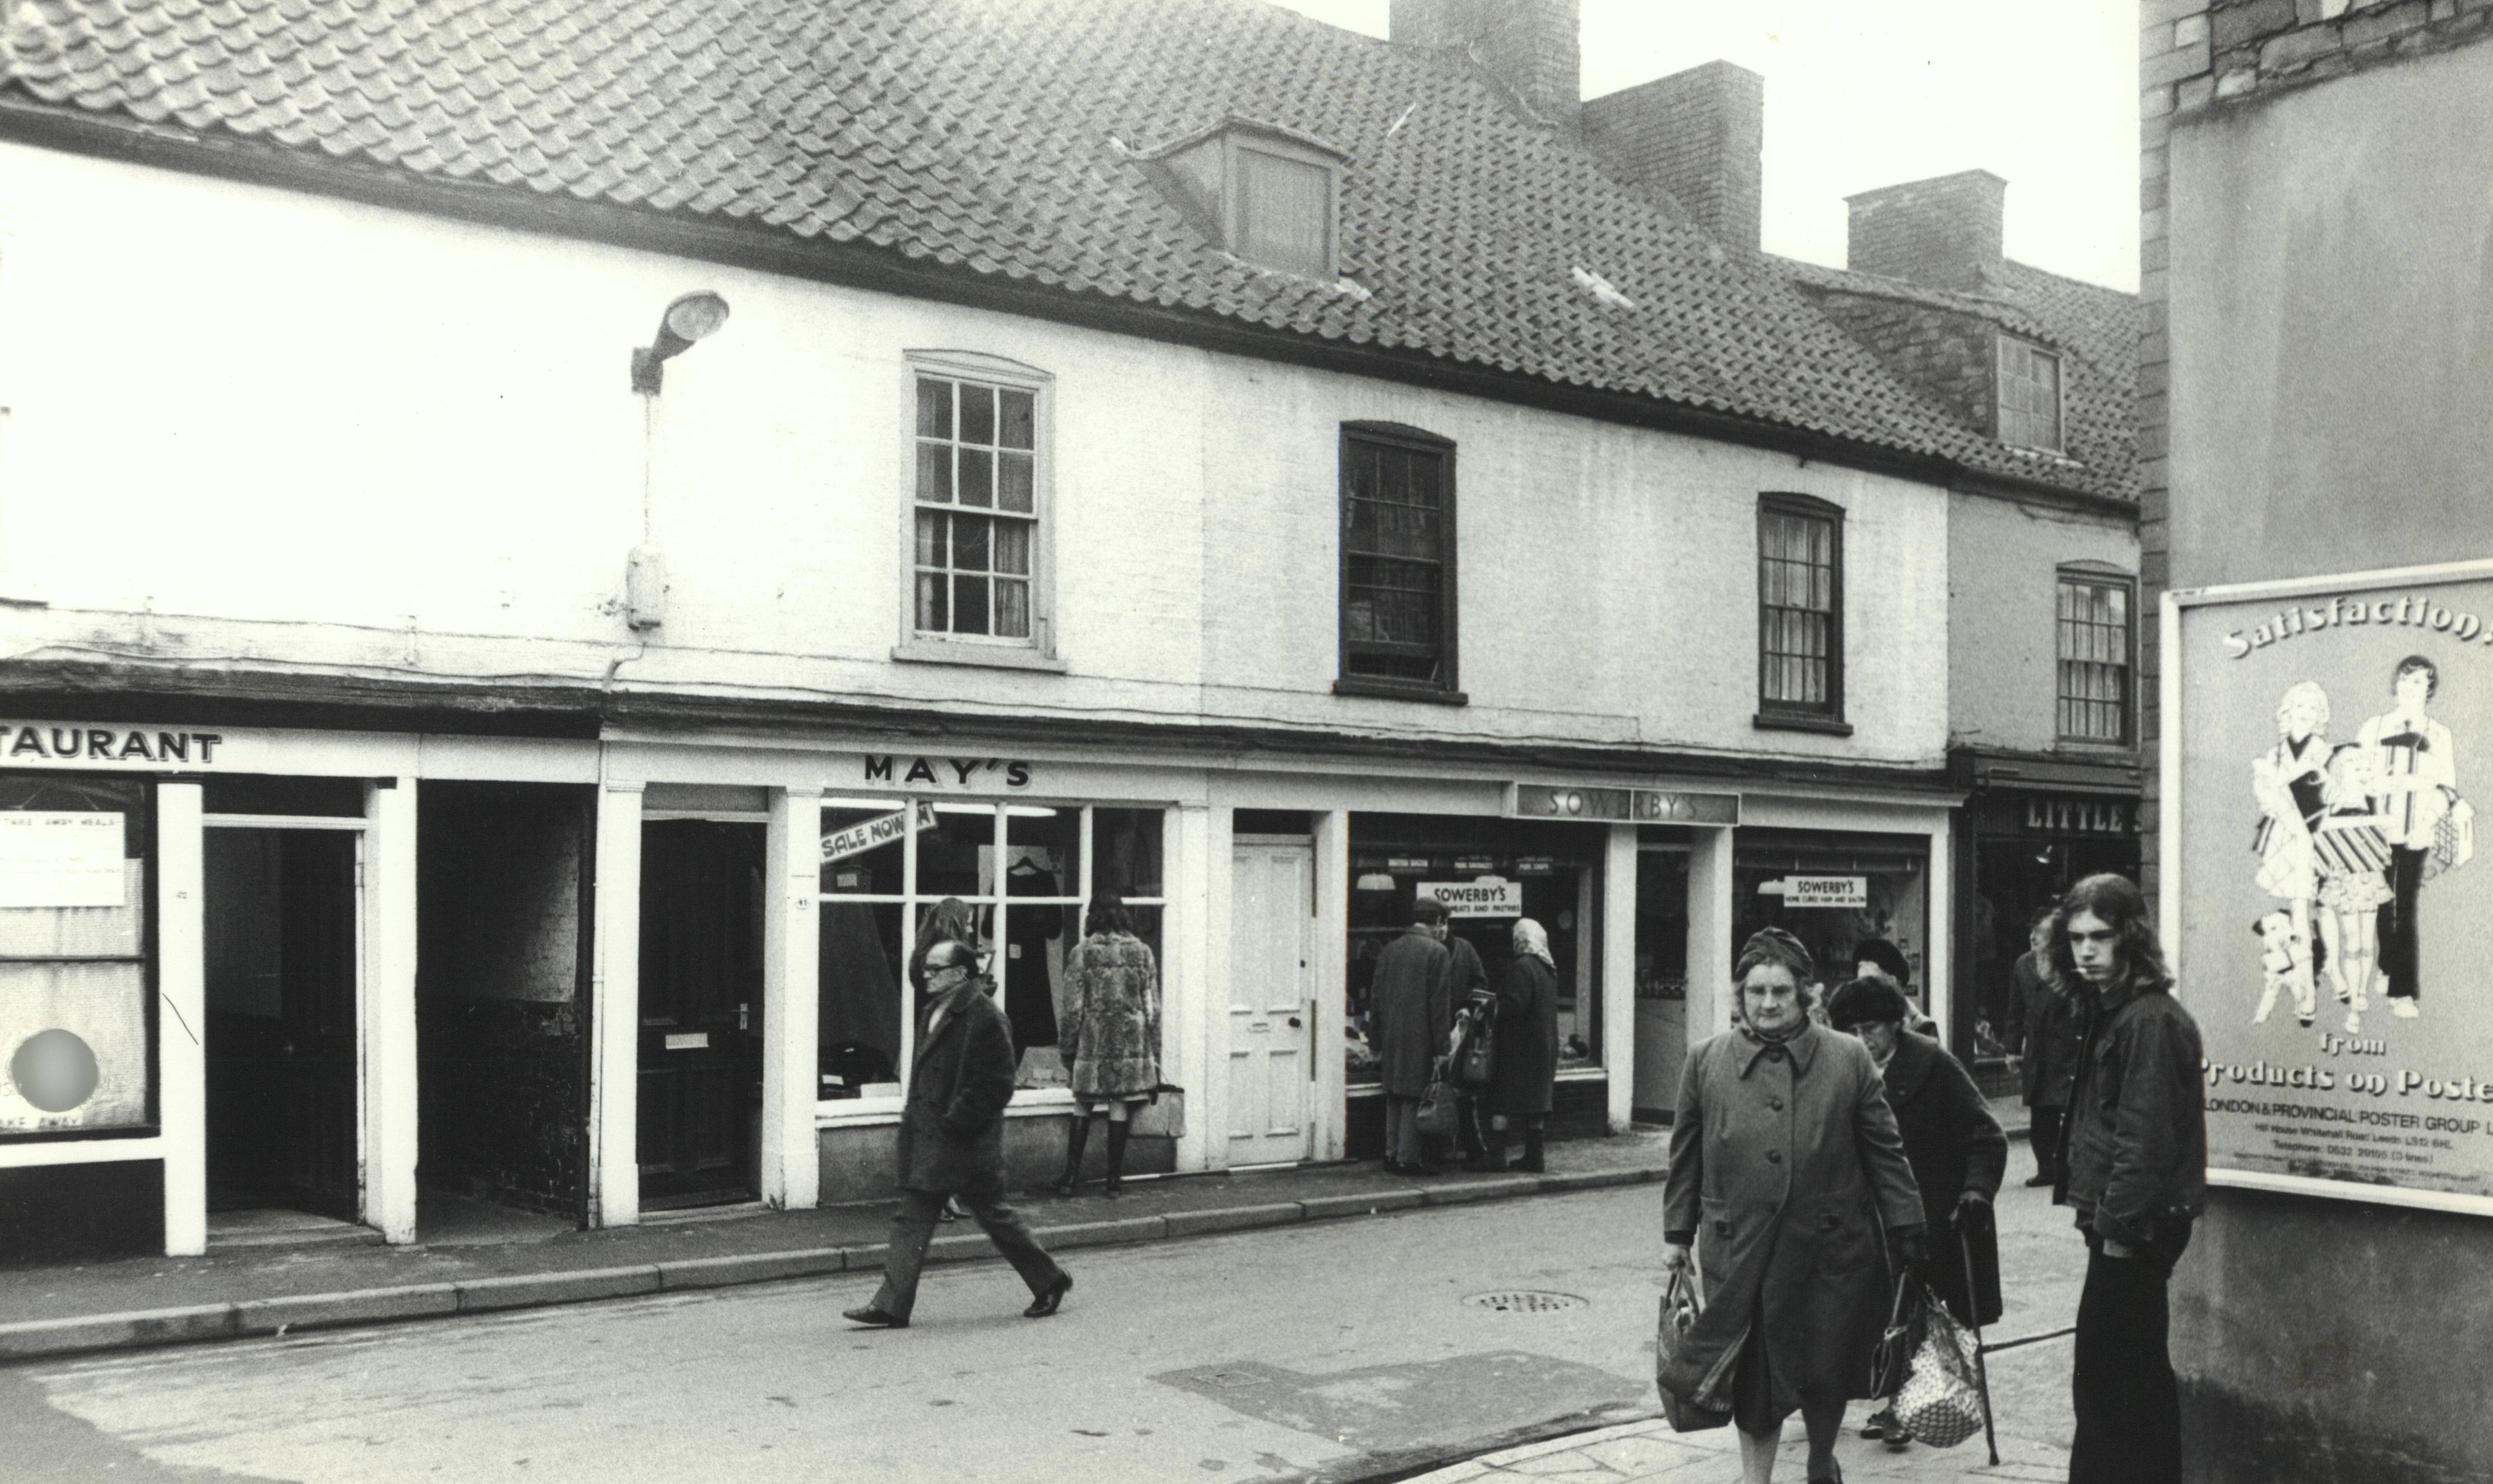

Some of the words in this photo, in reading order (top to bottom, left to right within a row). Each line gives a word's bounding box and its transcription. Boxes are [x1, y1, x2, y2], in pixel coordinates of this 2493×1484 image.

[865, 755, 1029, 787] MAY'S
[2028, 801, 2122, 832] LITTLE
[821, 828, 867, 858] SALE
[870, 815, 904, 842] NOW
[1434, 885, 1506, 903] SOWERBY'S
[1798, 880, 1854, 894] SOWERBY'S
[2320, 1032, 2386, 1056] from
[2347, 1072, 2387, 1096] on
[2359, 1110, 2420, 1129] POSTER
[2425, 1116, 2480, 1134] GROUP
[2326, 1145, 2352, 1156] 0532
[2372, 1134, 2402, 1145] Leeds
[2404, 1136, 2430, 1147] LS12
